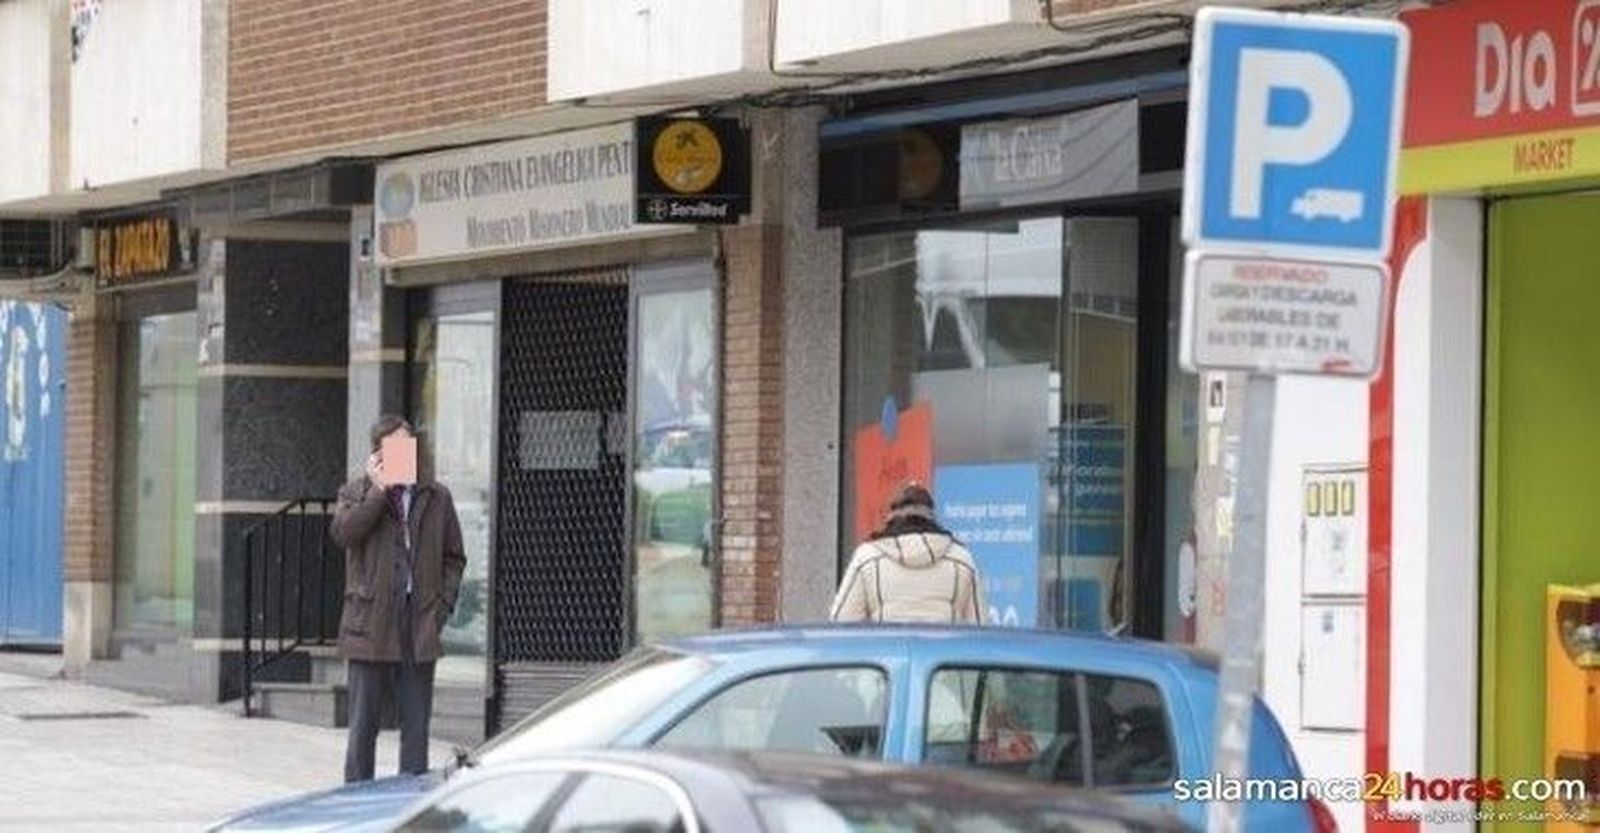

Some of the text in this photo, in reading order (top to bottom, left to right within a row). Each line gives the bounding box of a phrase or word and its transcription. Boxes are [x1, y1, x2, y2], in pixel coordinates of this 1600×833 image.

[1229, 47, 1354, 219] P
[1514, 138, 1575, 175] MARKET
[420, 169, 460, 204] IGLESIA
[464, 160, 524, 199] CRISTIANA
[1261, 286, 1358, 306] DESCARGA
